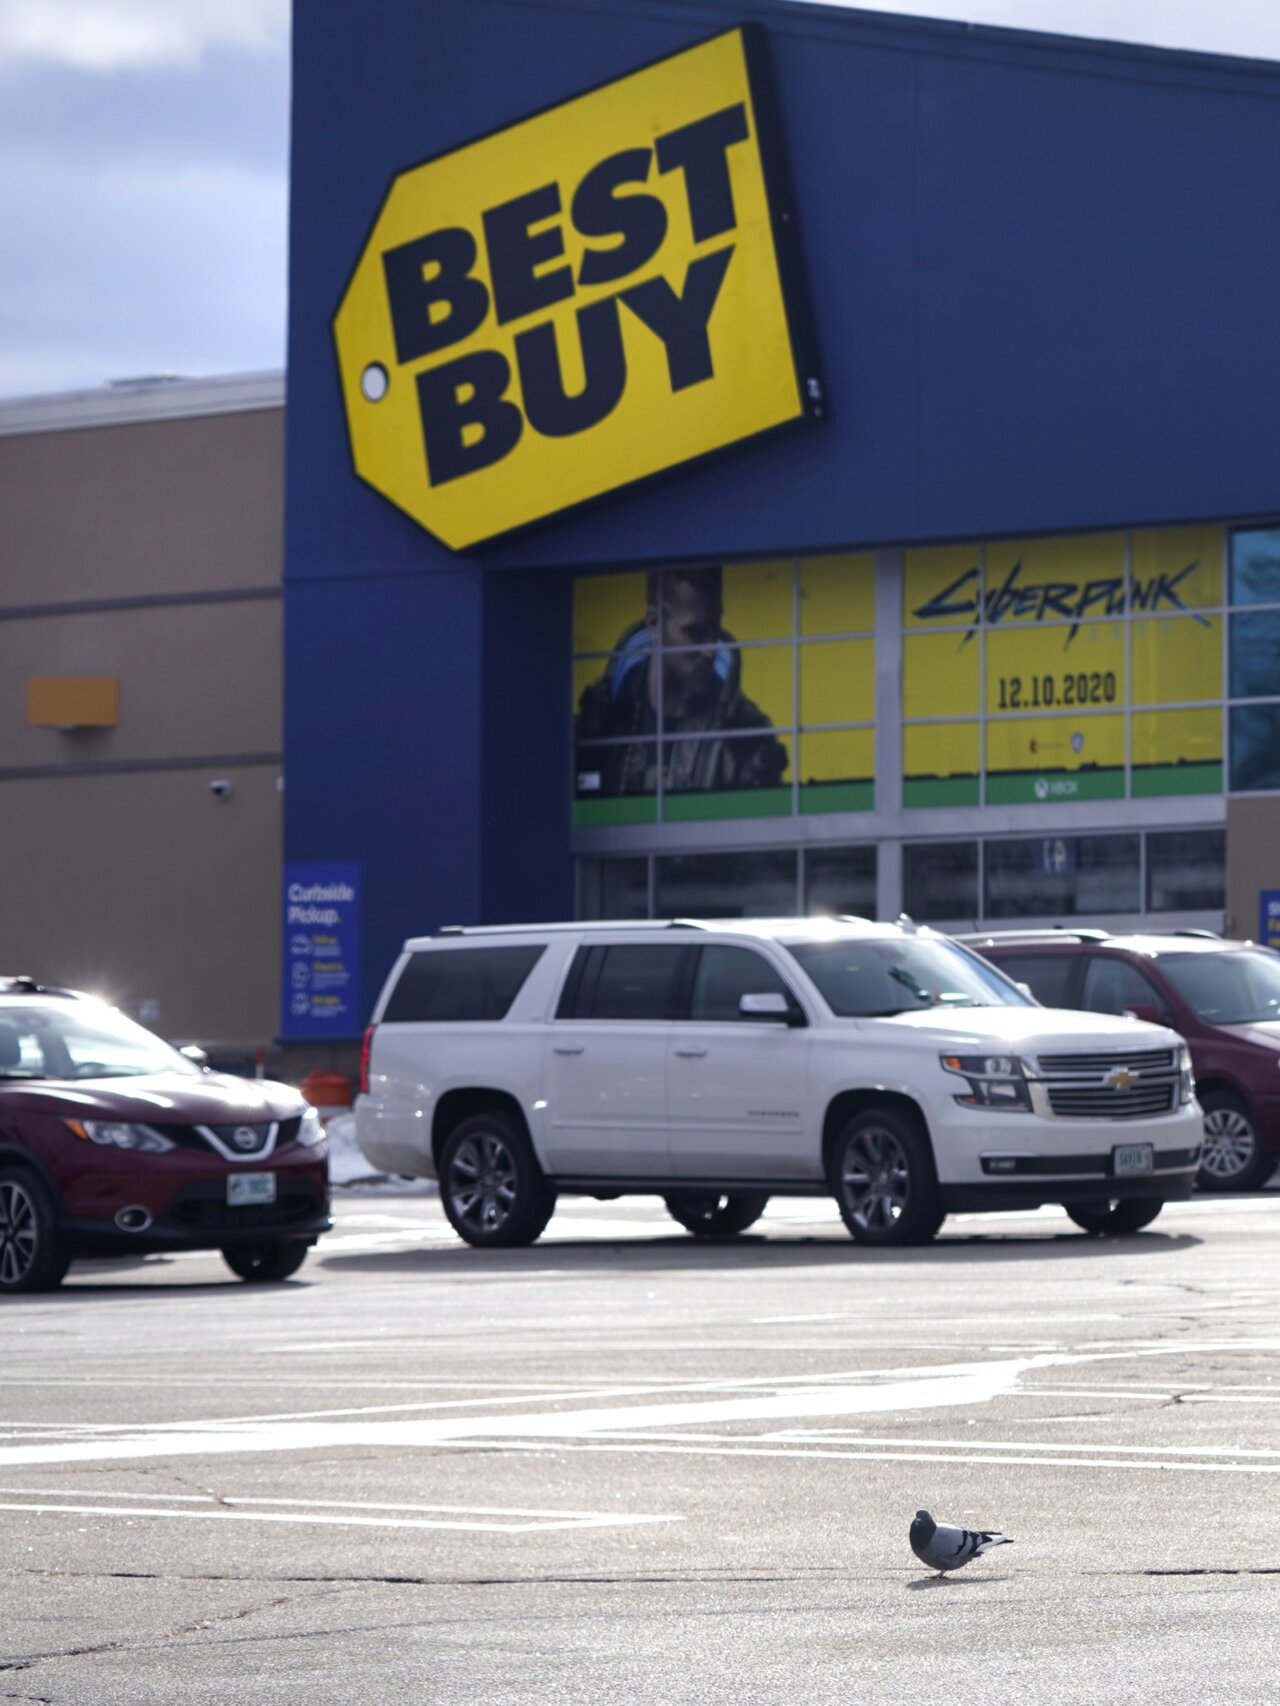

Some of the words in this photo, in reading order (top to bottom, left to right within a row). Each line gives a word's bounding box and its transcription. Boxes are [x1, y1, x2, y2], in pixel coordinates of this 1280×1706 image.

[381, 101, 750, 366] BEST
[415, 243, 737, 489] BUY
[998, 671, 1116, 709] 12.10.2020
[287, 882, 355, 902] Curbside
